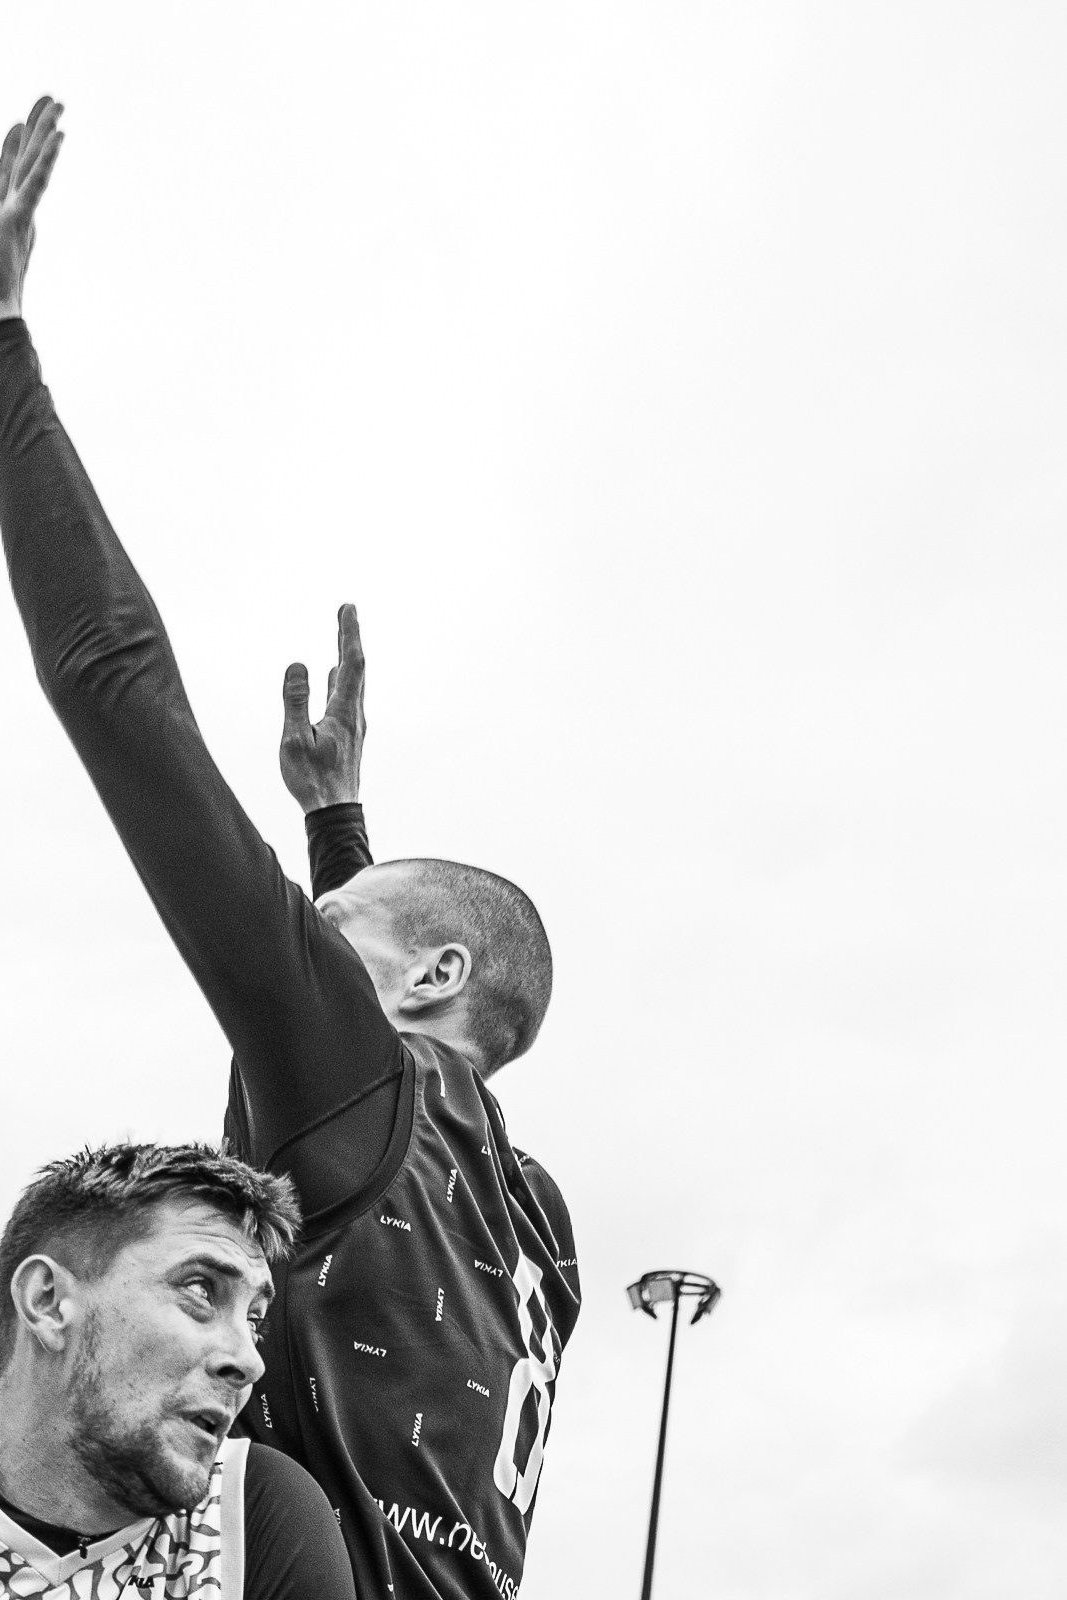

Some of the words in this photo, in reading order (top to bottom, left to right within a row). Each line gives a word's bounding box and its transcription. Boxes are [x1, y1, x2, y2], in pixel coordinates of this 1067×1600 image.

[447, 1168, 457, 1203] LYKIA
[380, 1216, 411, 1231] LYKIA
[318, 1255, 332, 1286] LYKIA
[475, 1259, 504, 1278] LYKIA
[435, 1288, 444, 1321] LYKIA
[354, 1342, 386, 1357] LYKIA
[467, 1380, 489, 1397] LYKIA
[261, 1394, 272, 1427] LYKIA
[412, 1413, 423, 1446] LYKIA
